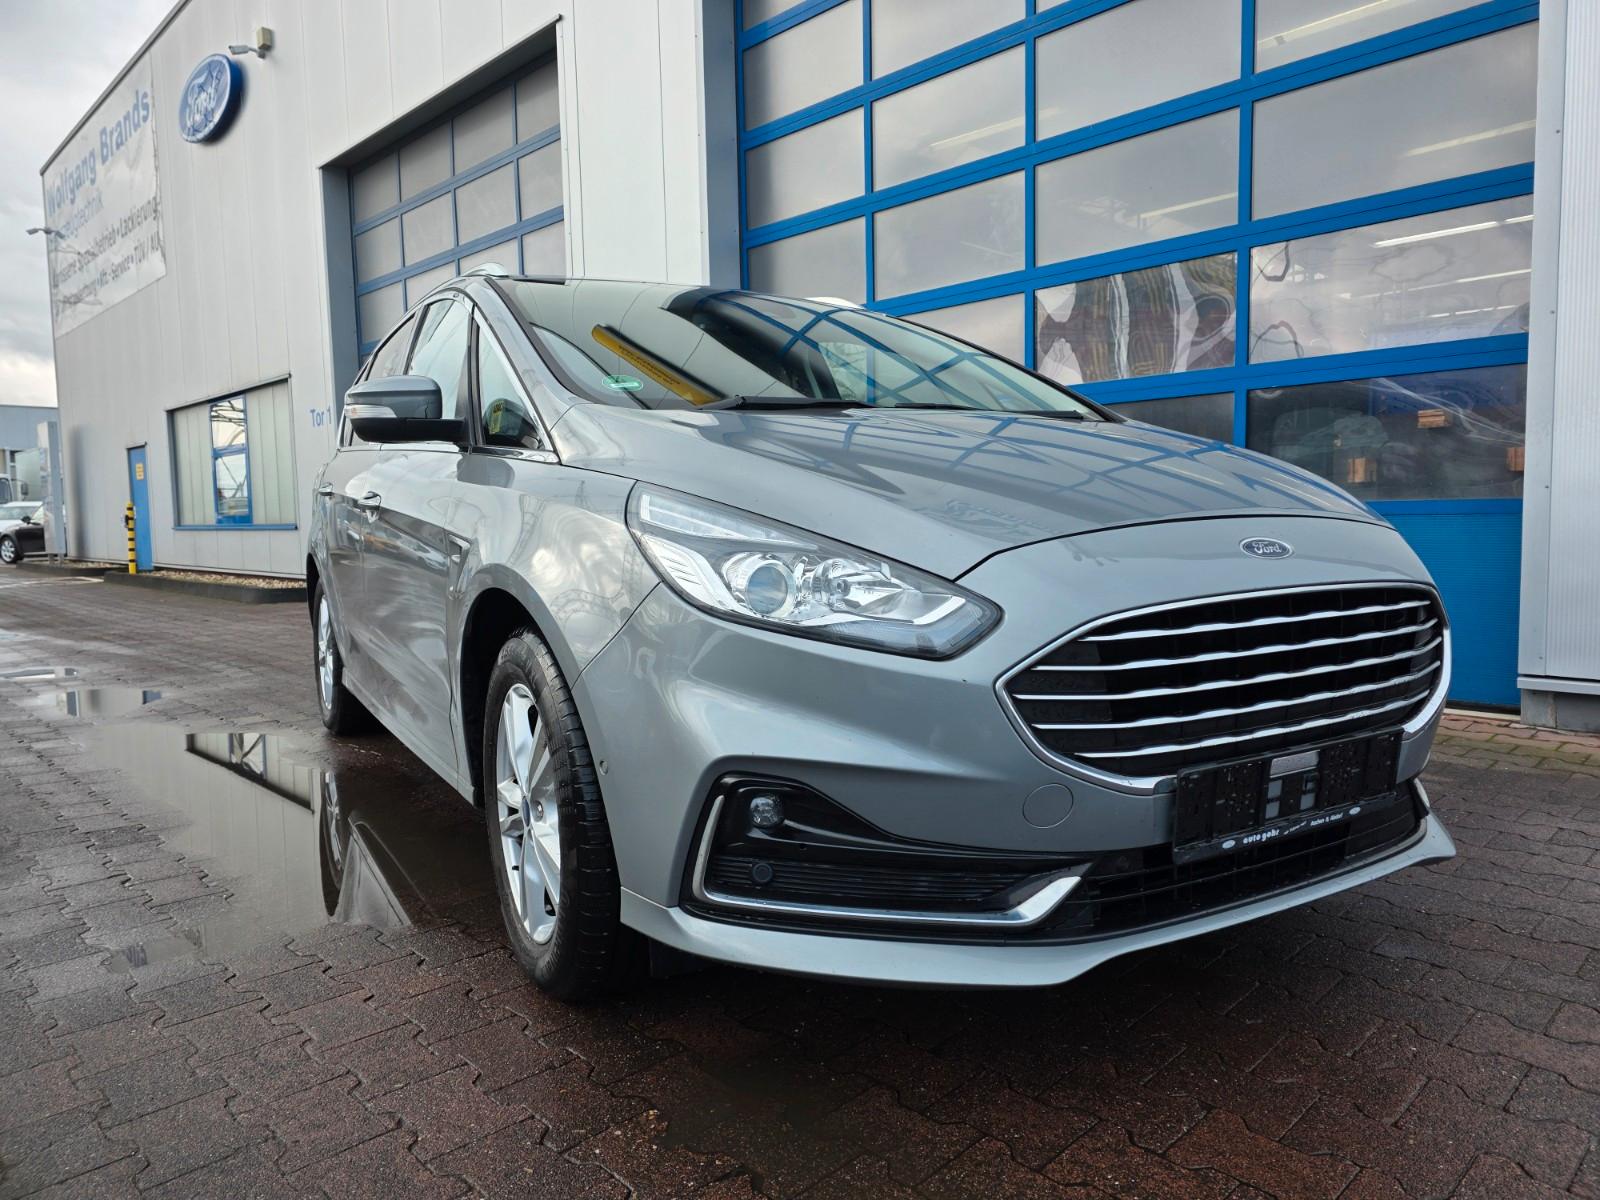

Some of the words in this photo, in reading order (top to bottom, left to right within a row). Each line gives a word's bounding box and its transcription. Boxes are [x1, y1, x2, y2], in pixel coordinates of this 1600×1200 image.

[47, 148, 97, 217] Wolfgang
[100, 89, 150, 165] Brands
[310, 408, 325, 428] Tor
[326, 404, 332, 425] 1
[1252, 541, 1282, 554] Ford
